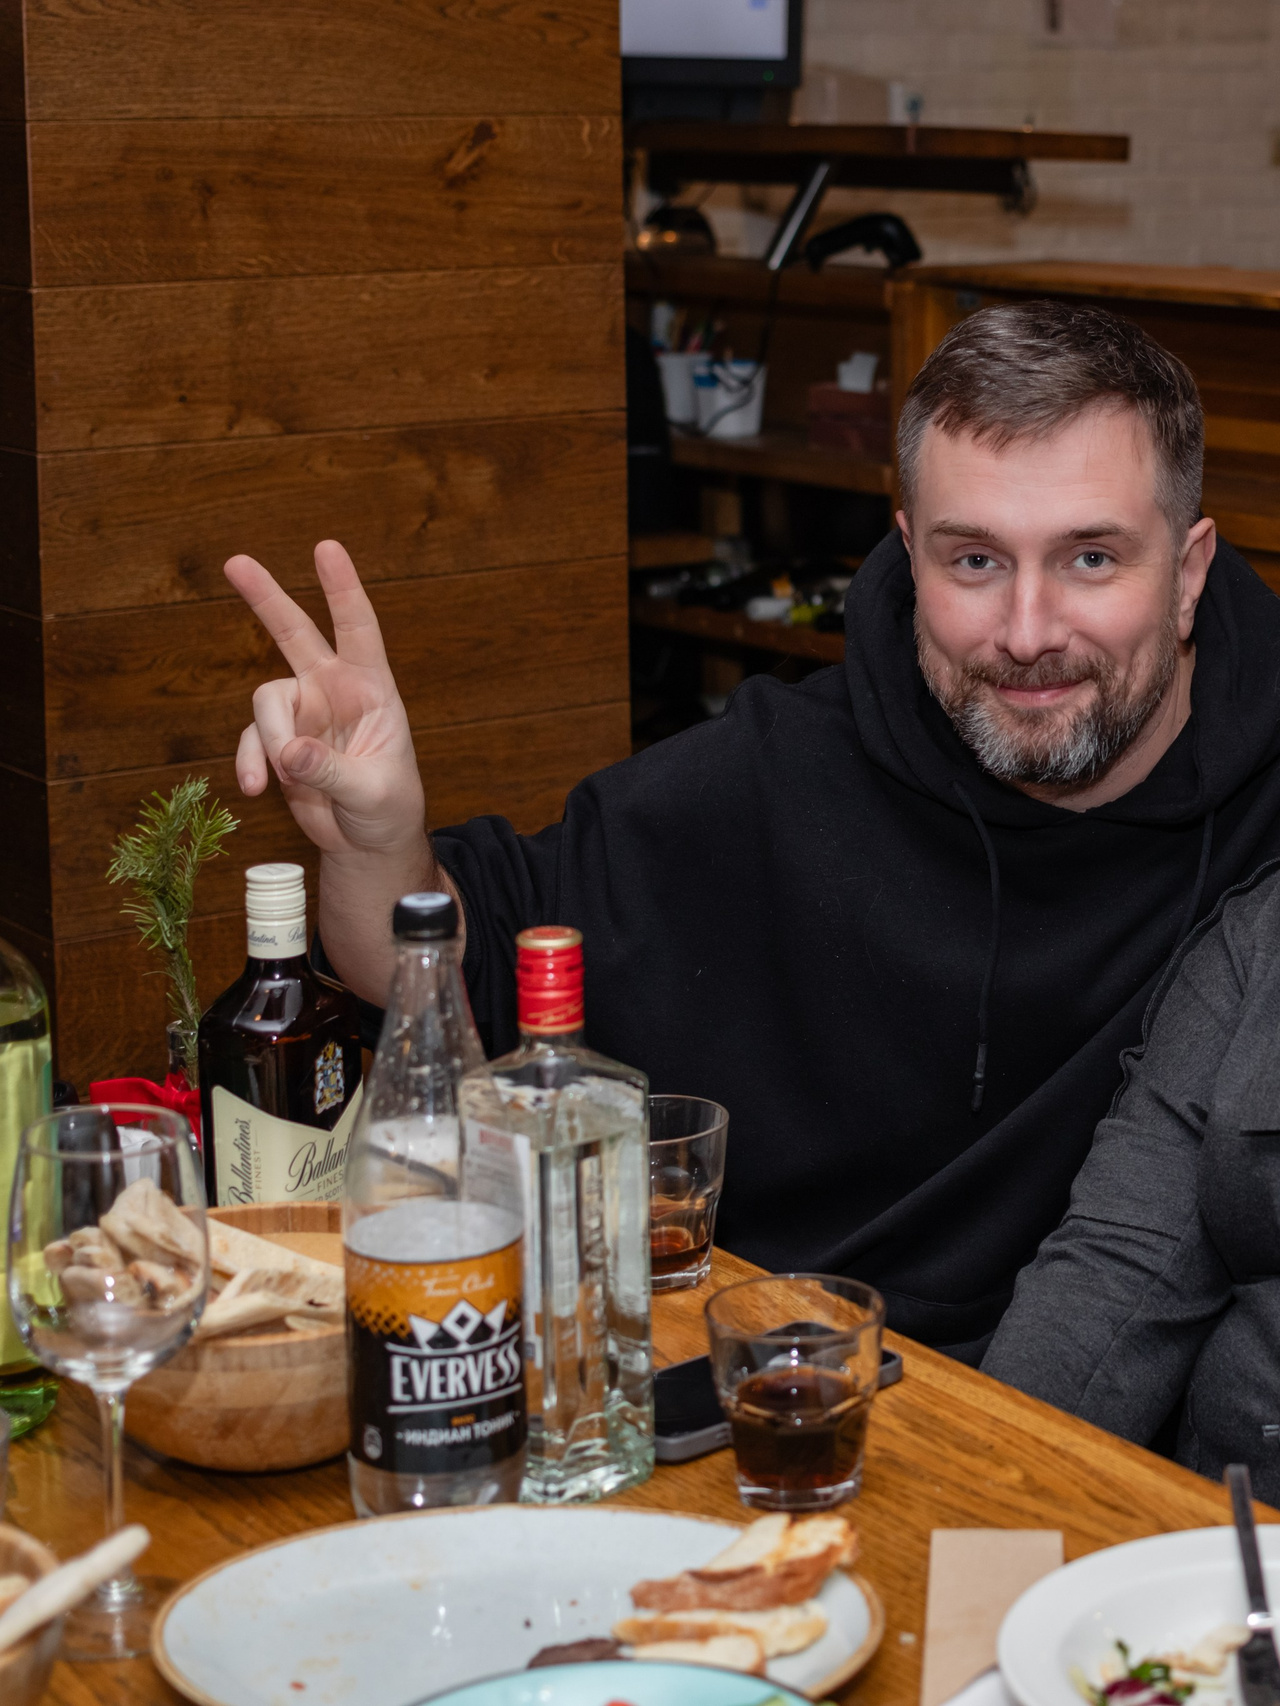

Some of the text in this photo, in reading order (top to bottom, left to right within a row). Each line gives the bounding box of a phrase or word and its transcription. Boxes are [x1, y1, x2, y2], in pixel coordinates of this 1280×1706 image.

[253, 1151, 262, 1190] FINEST
[285, 1132, 351, 1193] Ballant
[317, 1170, 344, 1193] FINES
[391, 1337, 521, 1402] EVERVESS
